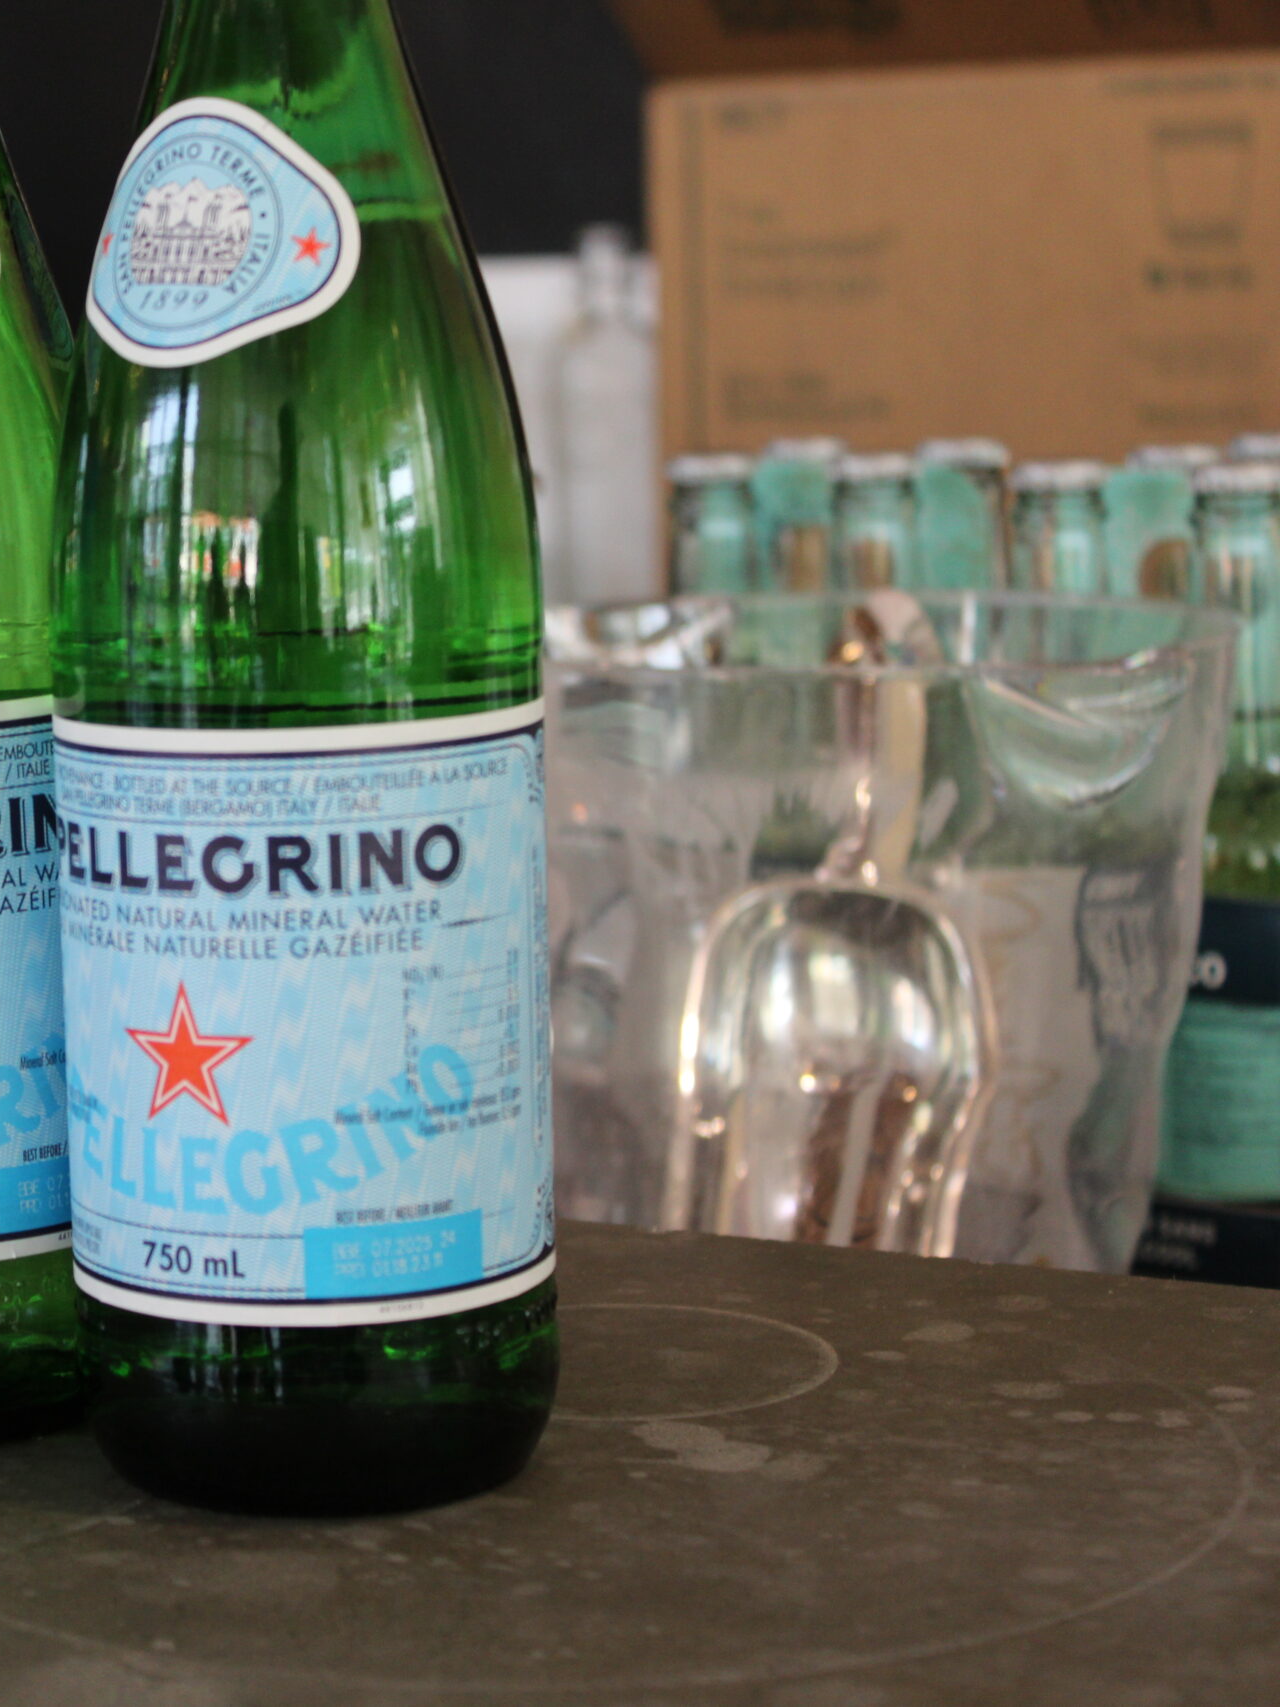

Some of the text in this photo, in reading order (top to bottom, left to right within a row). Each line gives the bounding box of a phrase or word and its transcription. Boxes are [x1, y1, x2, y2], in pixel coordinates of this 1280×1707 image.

[210, 145, 267, 198] TERME
[221, 232, 269, 295] ITALIA
[138, 289, 210, 312] 1899
[17, 758, 51, 779] ITALIE
[116, 904, 218, 932] NATURAL
[227, 910, 348, 933] MINERAL
[359, 899, 442, 928] WATER
[143, 932, 277, 960] NATURELLE
[289, 927, 424, 960] GAZÉIFIÉE
[23, 1146, 38, 1162] BEST
[39, 1142, 62, 1159] BEFORE
[141, 1239, 246, 1280] 750 mL
